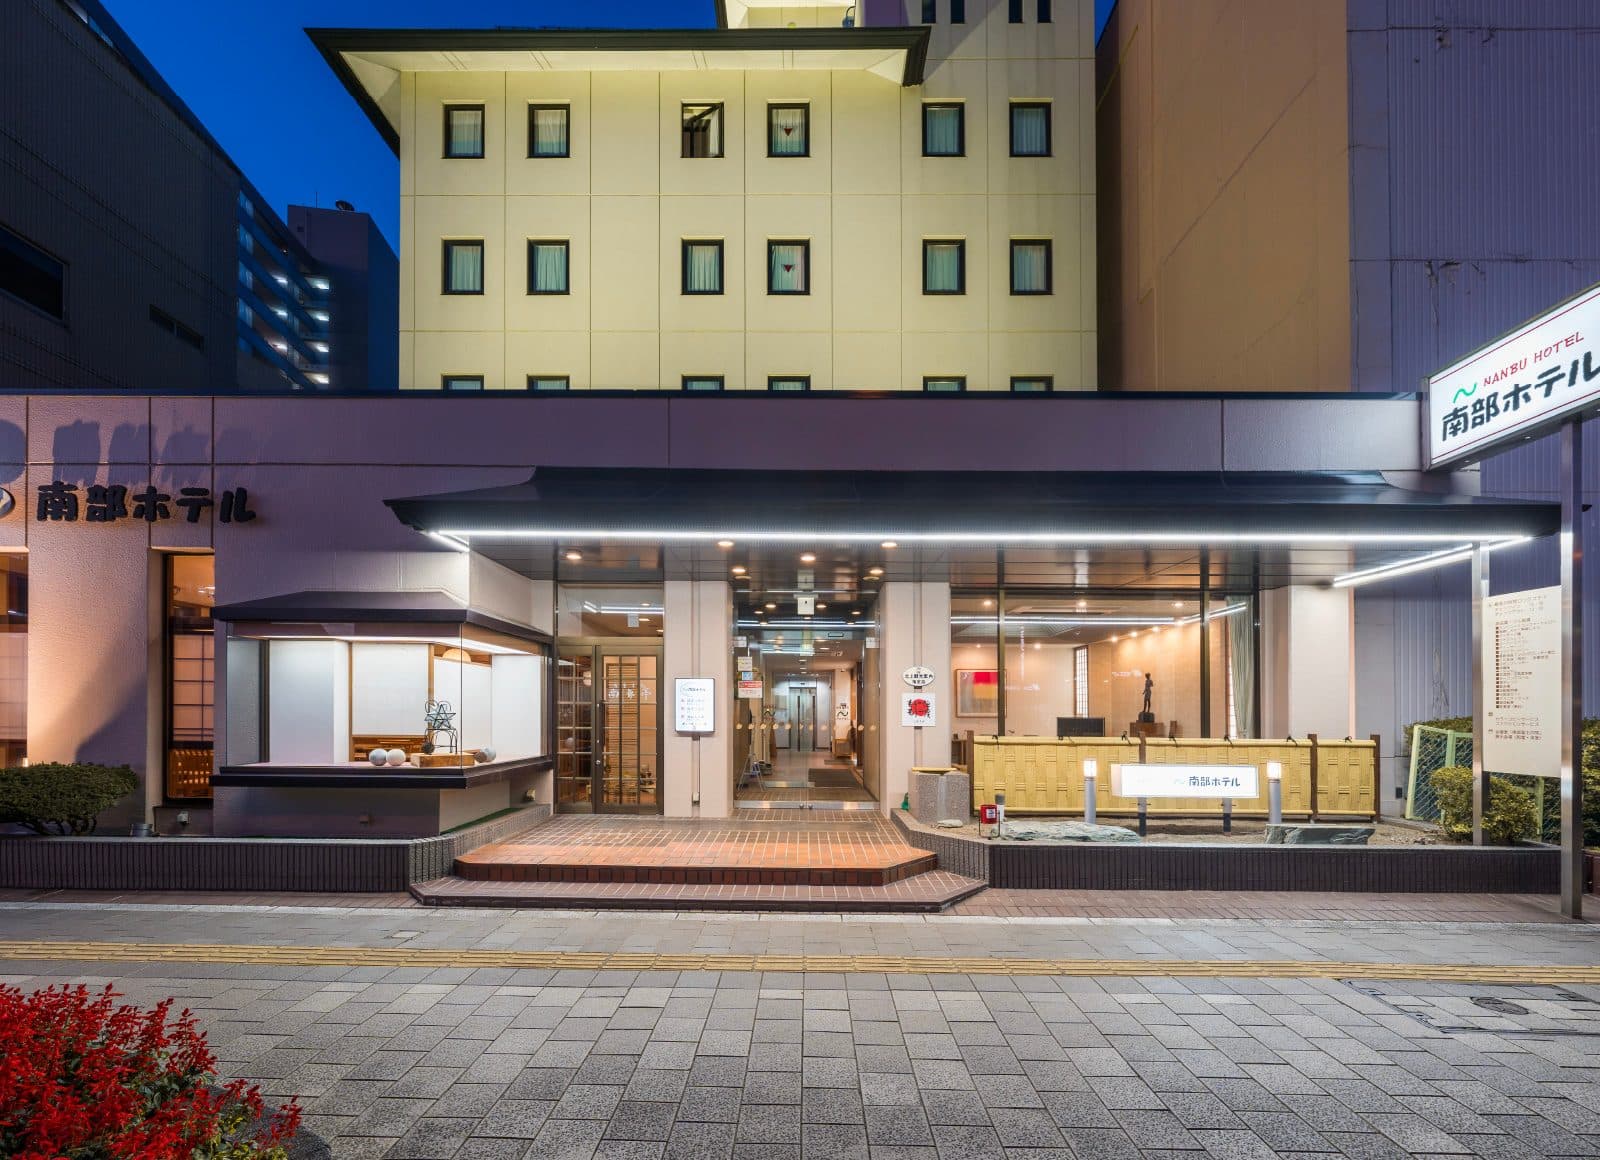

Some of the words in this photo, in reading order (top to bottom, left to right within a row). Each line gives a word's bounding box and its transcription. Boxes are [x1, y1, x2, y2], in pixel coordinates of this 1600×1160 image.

[1483, 358, 1528, 387] NANBU
[1534, 331, 1584, 364] HOTEL
[1442, 351, 1600, 441] 南部ホテル
[37, 480, 256, 523] 南部ホテル
[1188, 776, 1240, 787] 南部ホテル
